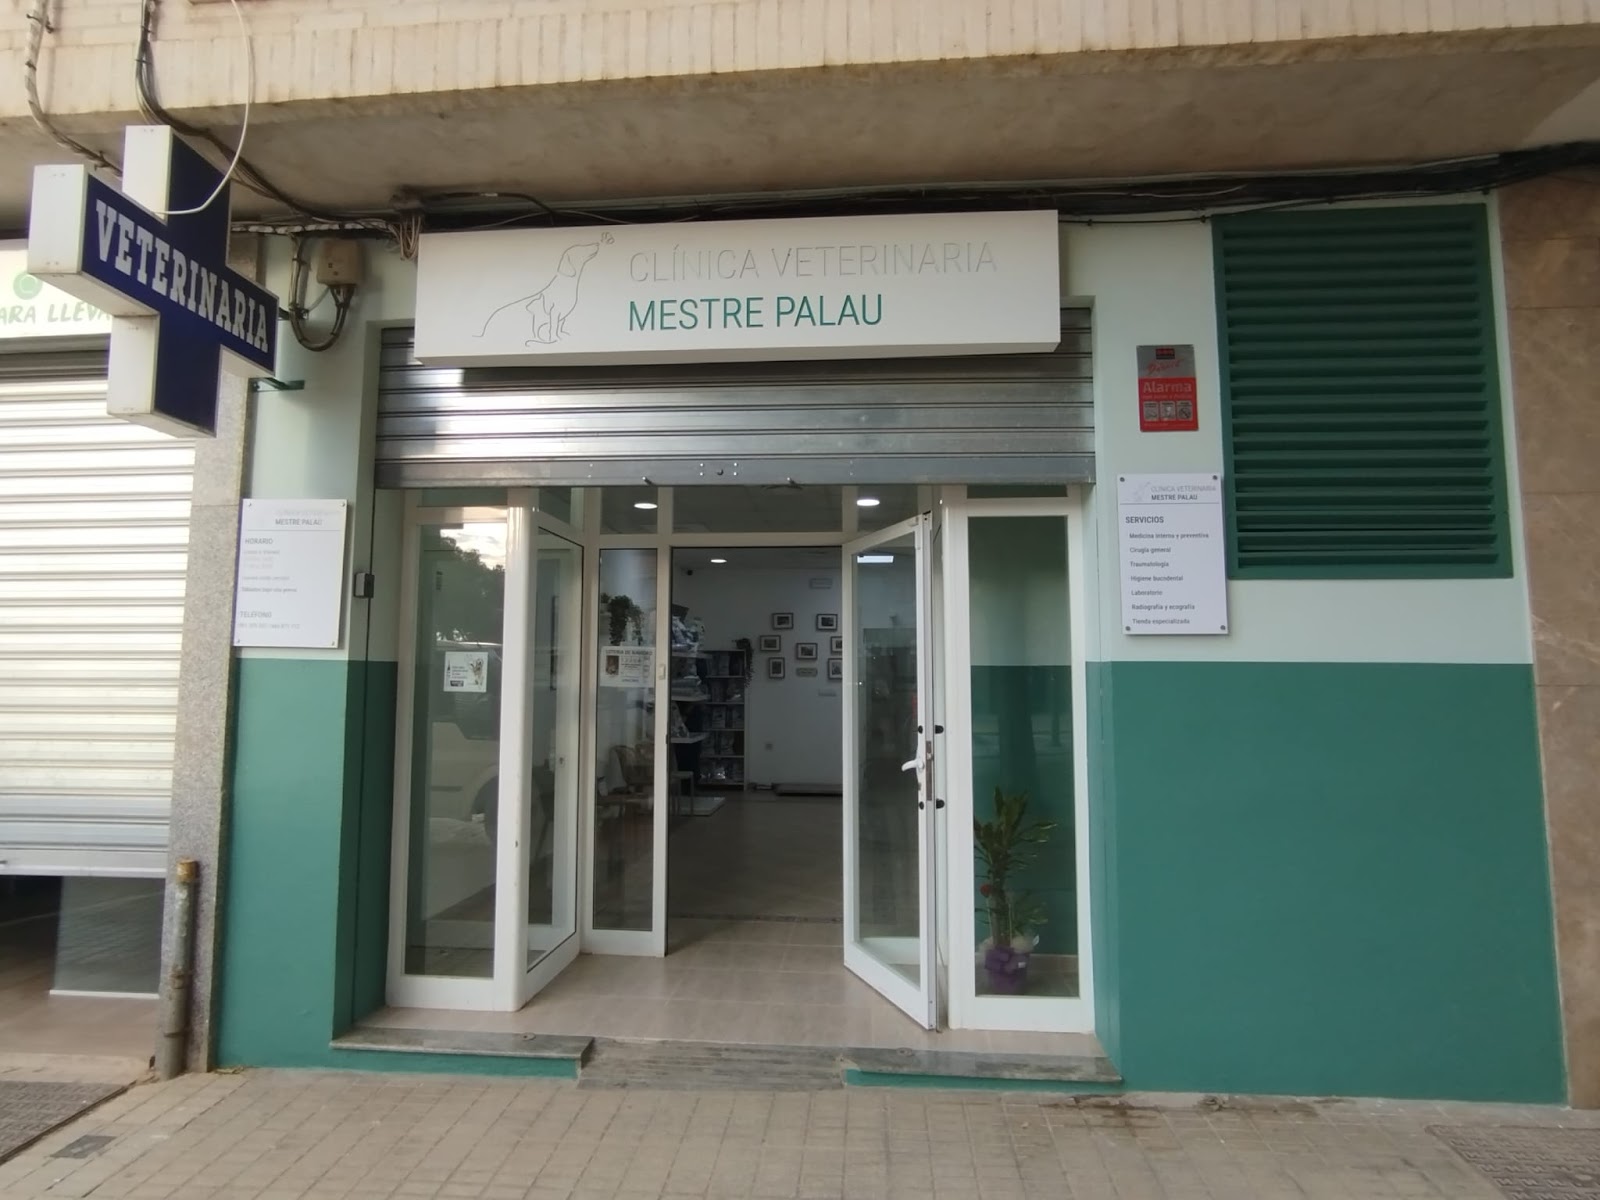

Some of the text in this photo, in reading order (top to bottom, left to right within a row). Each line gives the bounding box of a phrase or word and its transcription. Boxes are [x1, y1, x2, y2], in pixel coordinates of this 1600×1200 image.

[629, 241, 998, 282] CLÍNICA VETERINARIA
[95, 198, 269, 354] VETERINARIA
[629, 293, 883, 331] MESTRE PALAU
[1142, 381, 1193, 393] Alarma
[275, 518, 301, 526] MESTRE
[1125, 516, 1164, 524] SERVICIOS
[1129, 532, 1154, 540] Medicina
[1180, 532, 1209, 540] preventiva
[244, 537, 274, 545] HORARIO
[1150, 546, 1171, 554] general
[1130, 575, 1152, 583] Higiene
[1132, 617, 1190, 626] Tienda especializada
